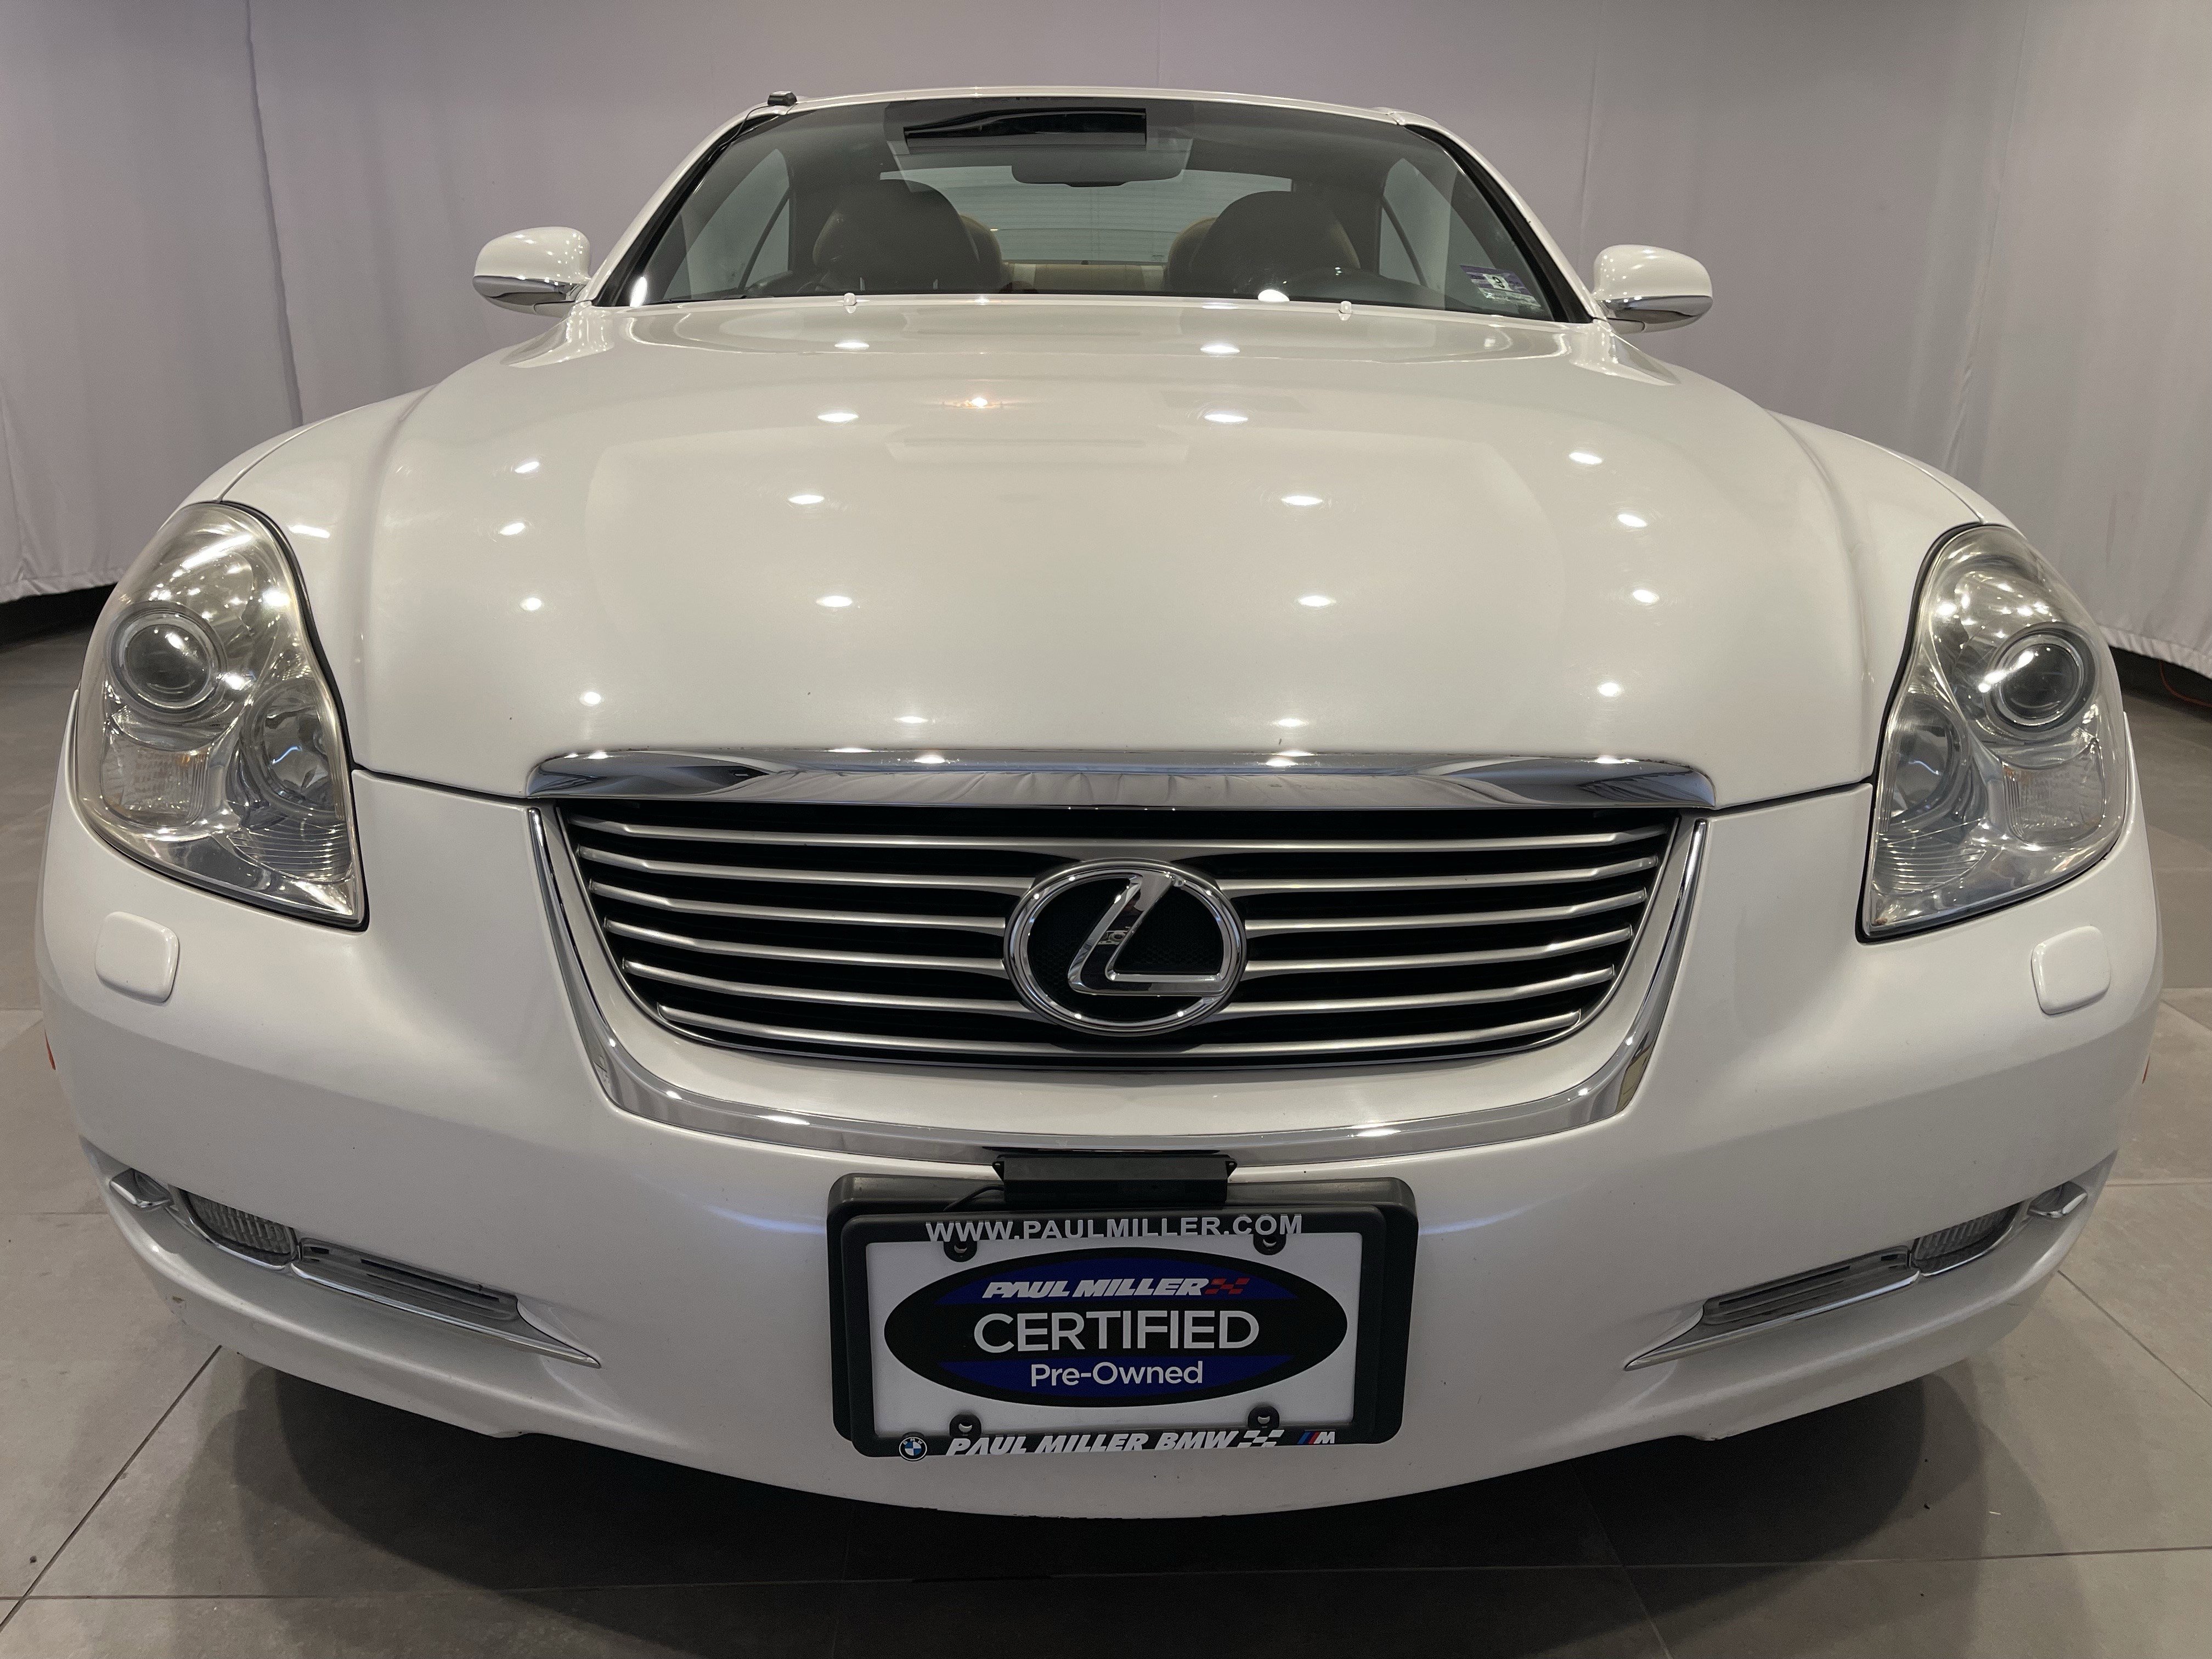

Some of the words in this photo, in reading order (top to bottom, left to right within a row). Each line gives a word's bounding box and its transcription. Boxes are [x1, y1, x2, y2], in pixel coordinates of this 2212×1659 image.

[926, 1213, 1302, 1243] WWW.PAULMILLER.COM
[982, 1280, 1070, 1299] PAUL
[1072, 1278, 1209, 1297] MILLER
[973, 1310, 1260, 1353] CERTIFIED
[1030, 1361, 1204, 1387] Pre-Owned
[945, 1436, 1028, 1456] PAUL
[1034, 1432, 1149, 1454] MILLER
[1154, 1430, 1239, 1451] BMW
